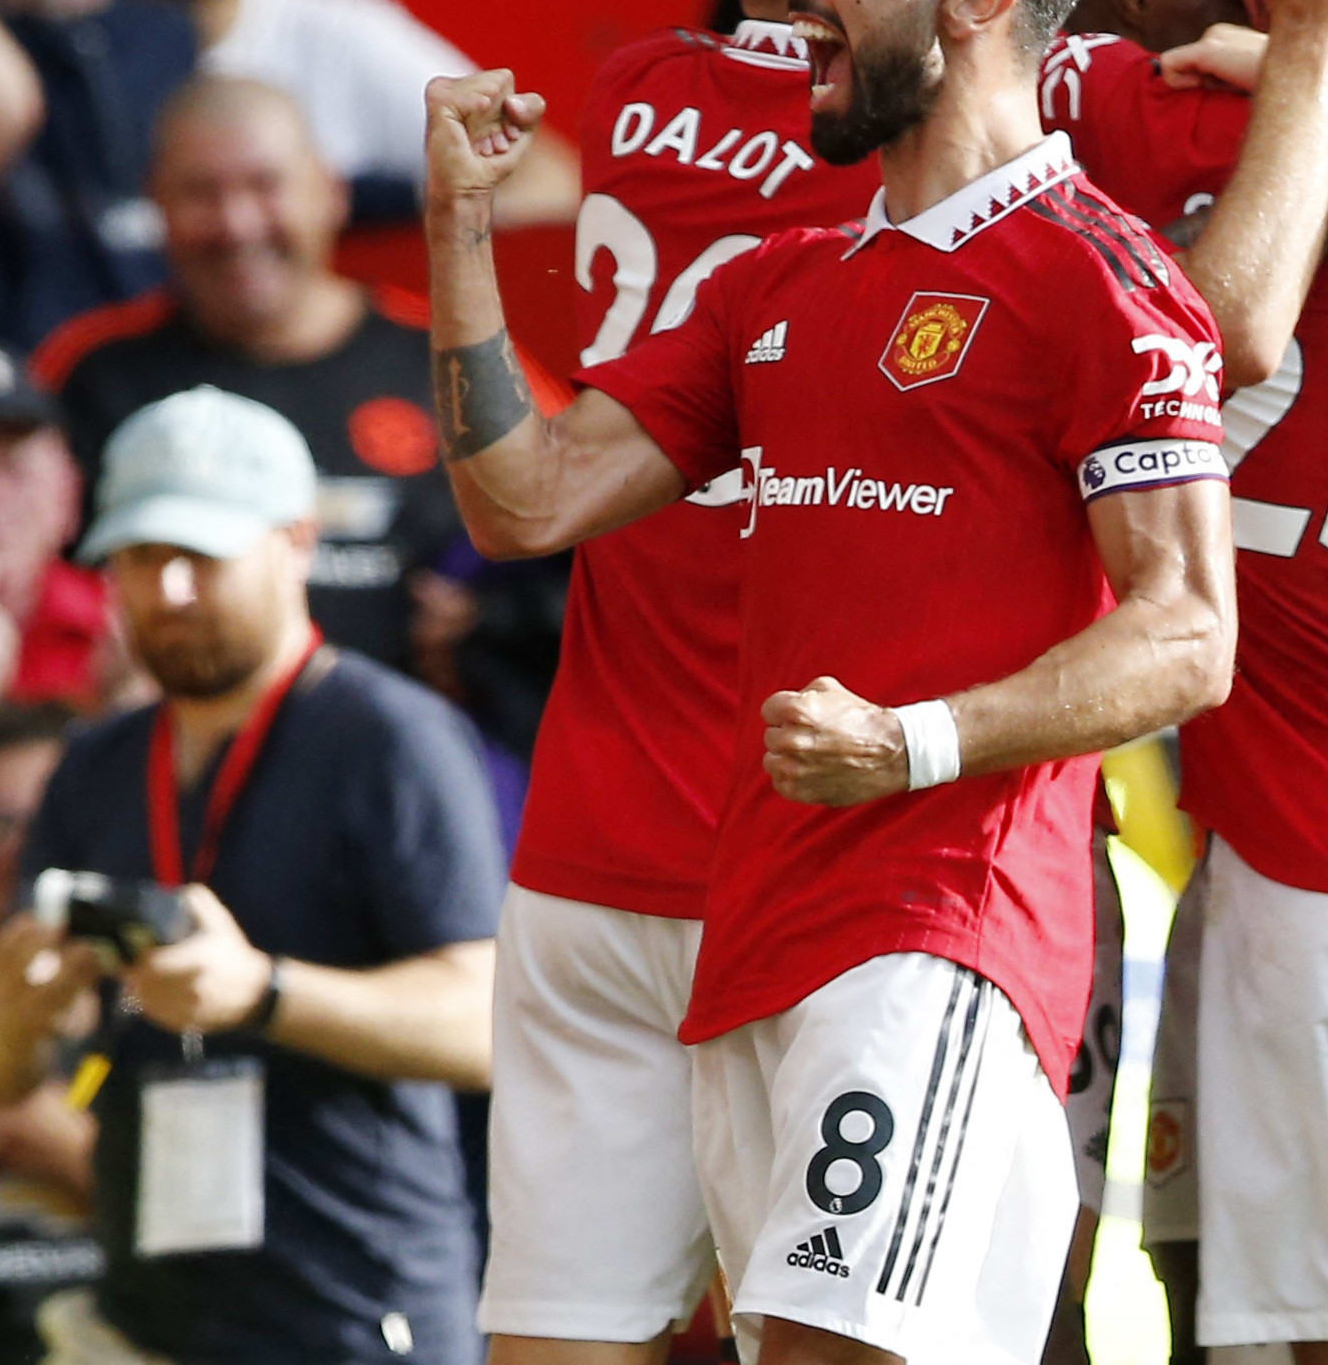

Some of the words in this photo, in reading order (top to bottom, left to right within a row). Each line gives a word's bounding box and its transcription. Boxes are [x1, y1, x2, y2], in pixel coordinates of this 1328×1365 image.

[611, 101, 815, 200] DALOT
[758, 466, 954, 516] TeamViewer
[805, 1090, 894, 1215] 8
[786, 1251, 850, 1279] adidas
